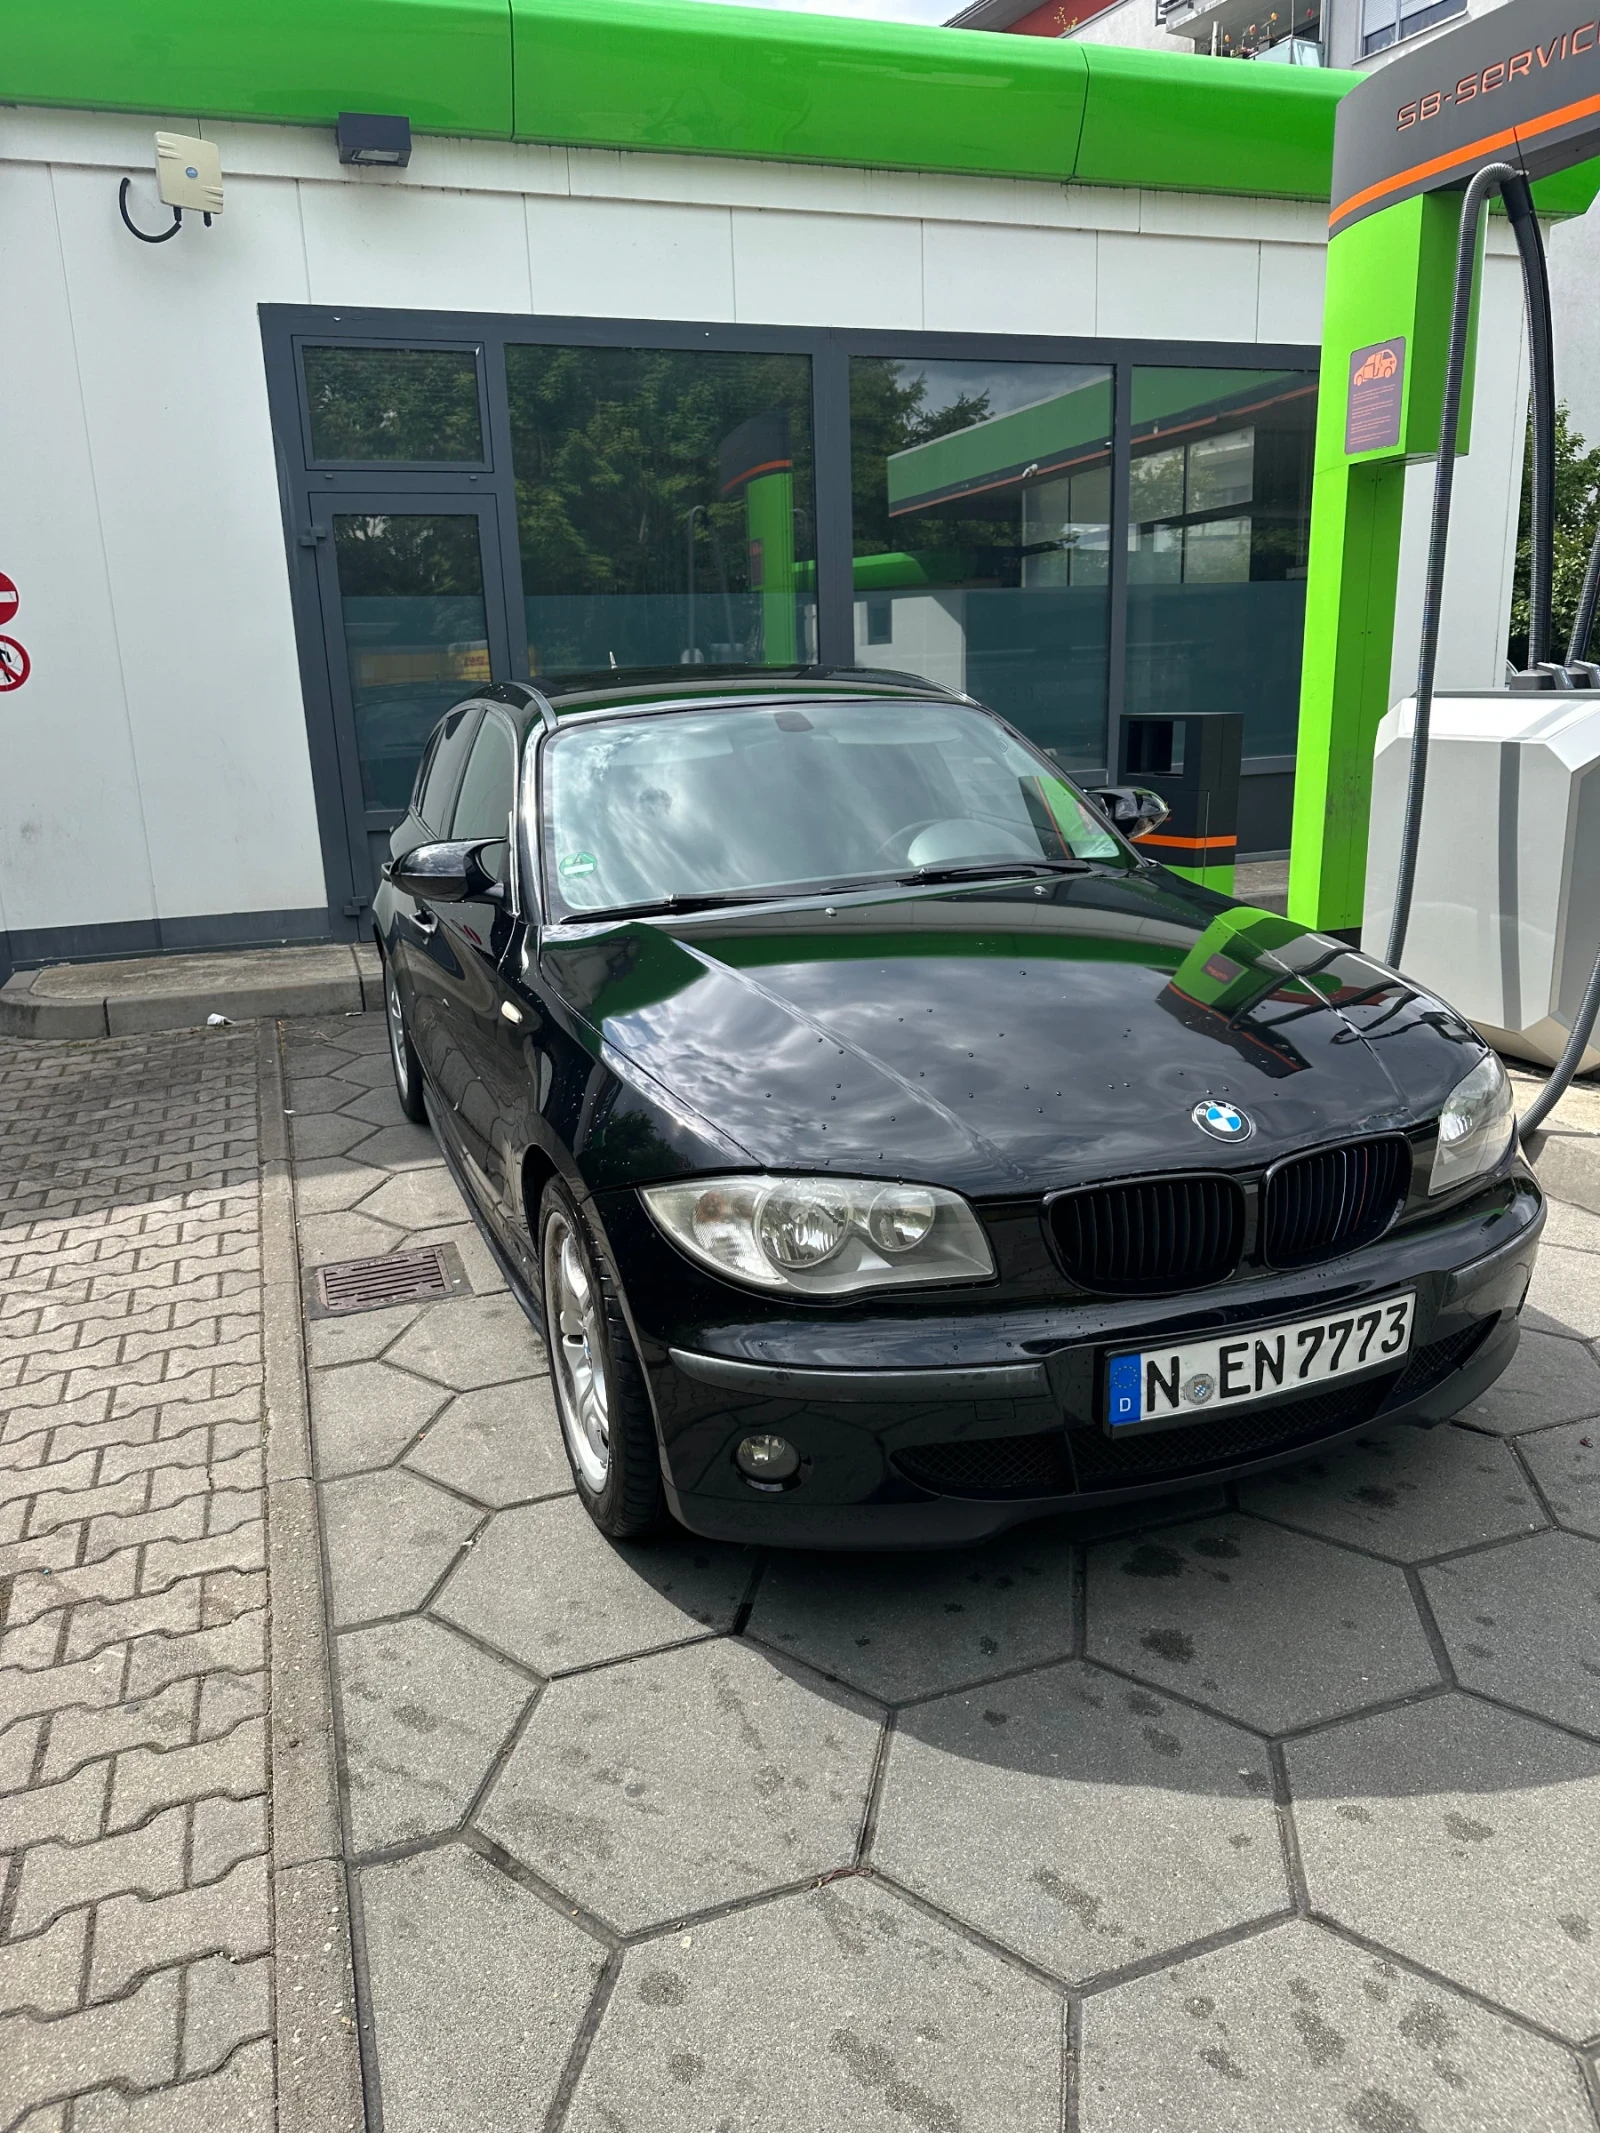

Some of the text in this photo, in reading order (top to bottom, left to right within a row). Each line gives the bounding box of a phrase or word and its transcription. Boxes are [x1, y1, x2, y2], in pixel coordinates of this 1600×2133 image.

[1396, 20, 1600, 131] SB-SERVIC
[1119, 1397, 1132, 1412] D
[1146, 1355, 1180, 1413] N
